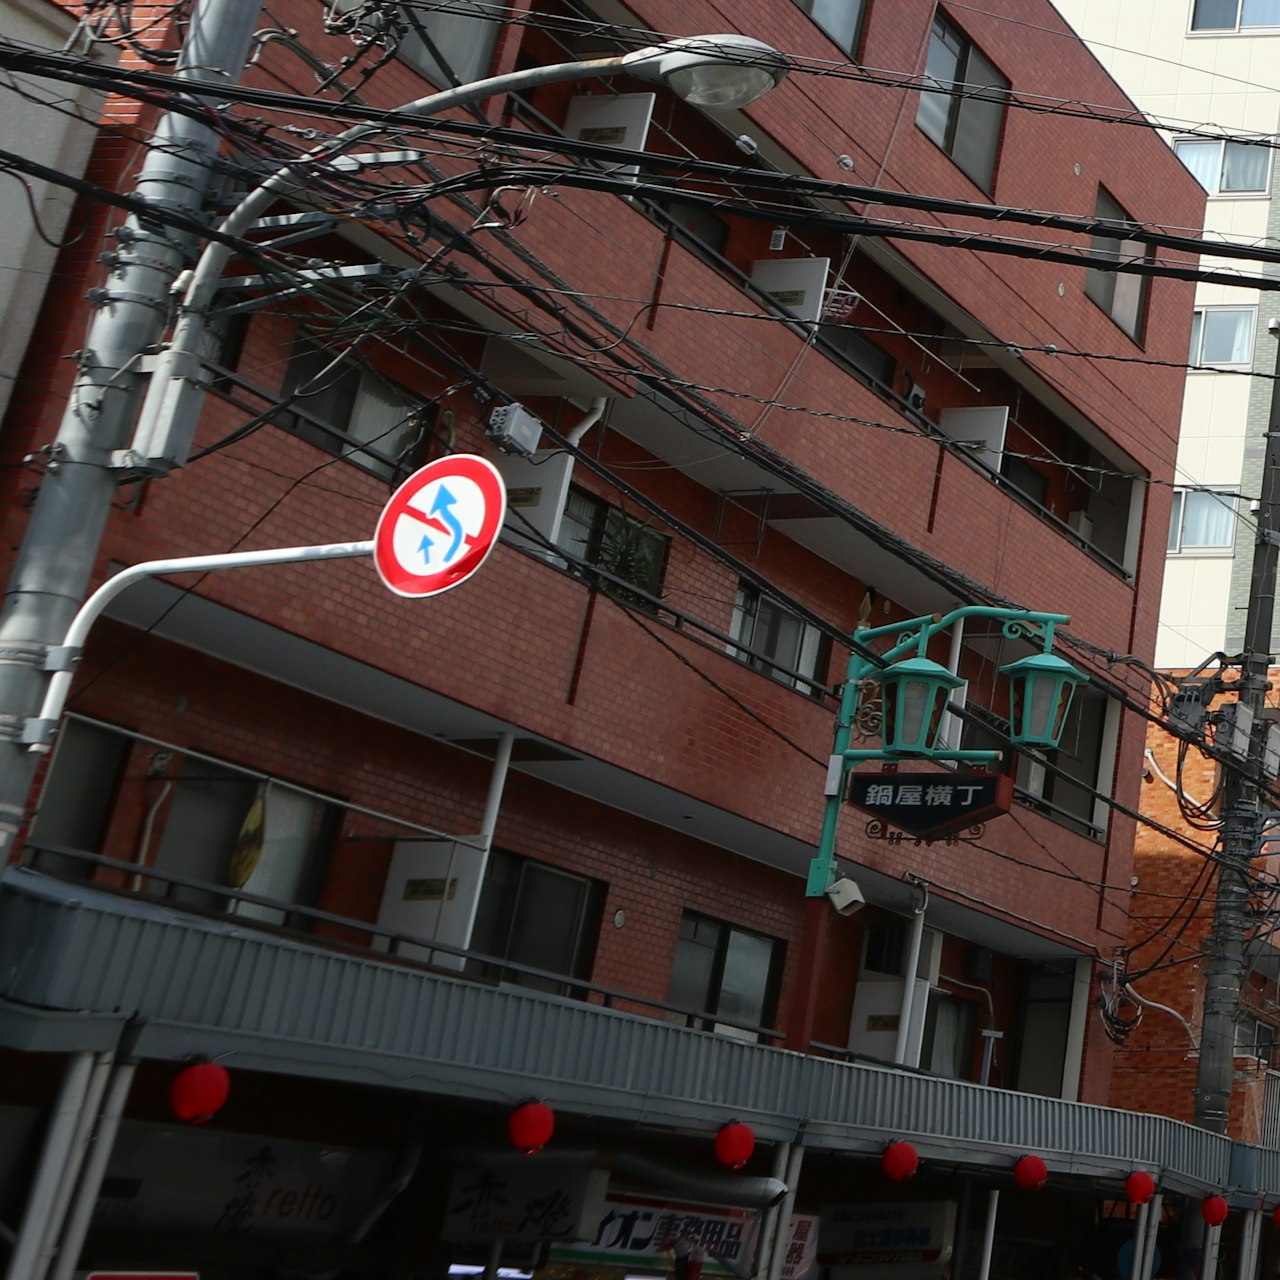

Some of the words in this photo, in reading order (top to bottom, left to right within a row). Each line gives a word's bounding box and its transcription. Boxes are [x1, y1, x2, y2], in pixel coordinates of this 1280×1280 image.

[864, 784, 984, 806] 鍋屋横丁
[264, 1183, 338, 1220] retto
